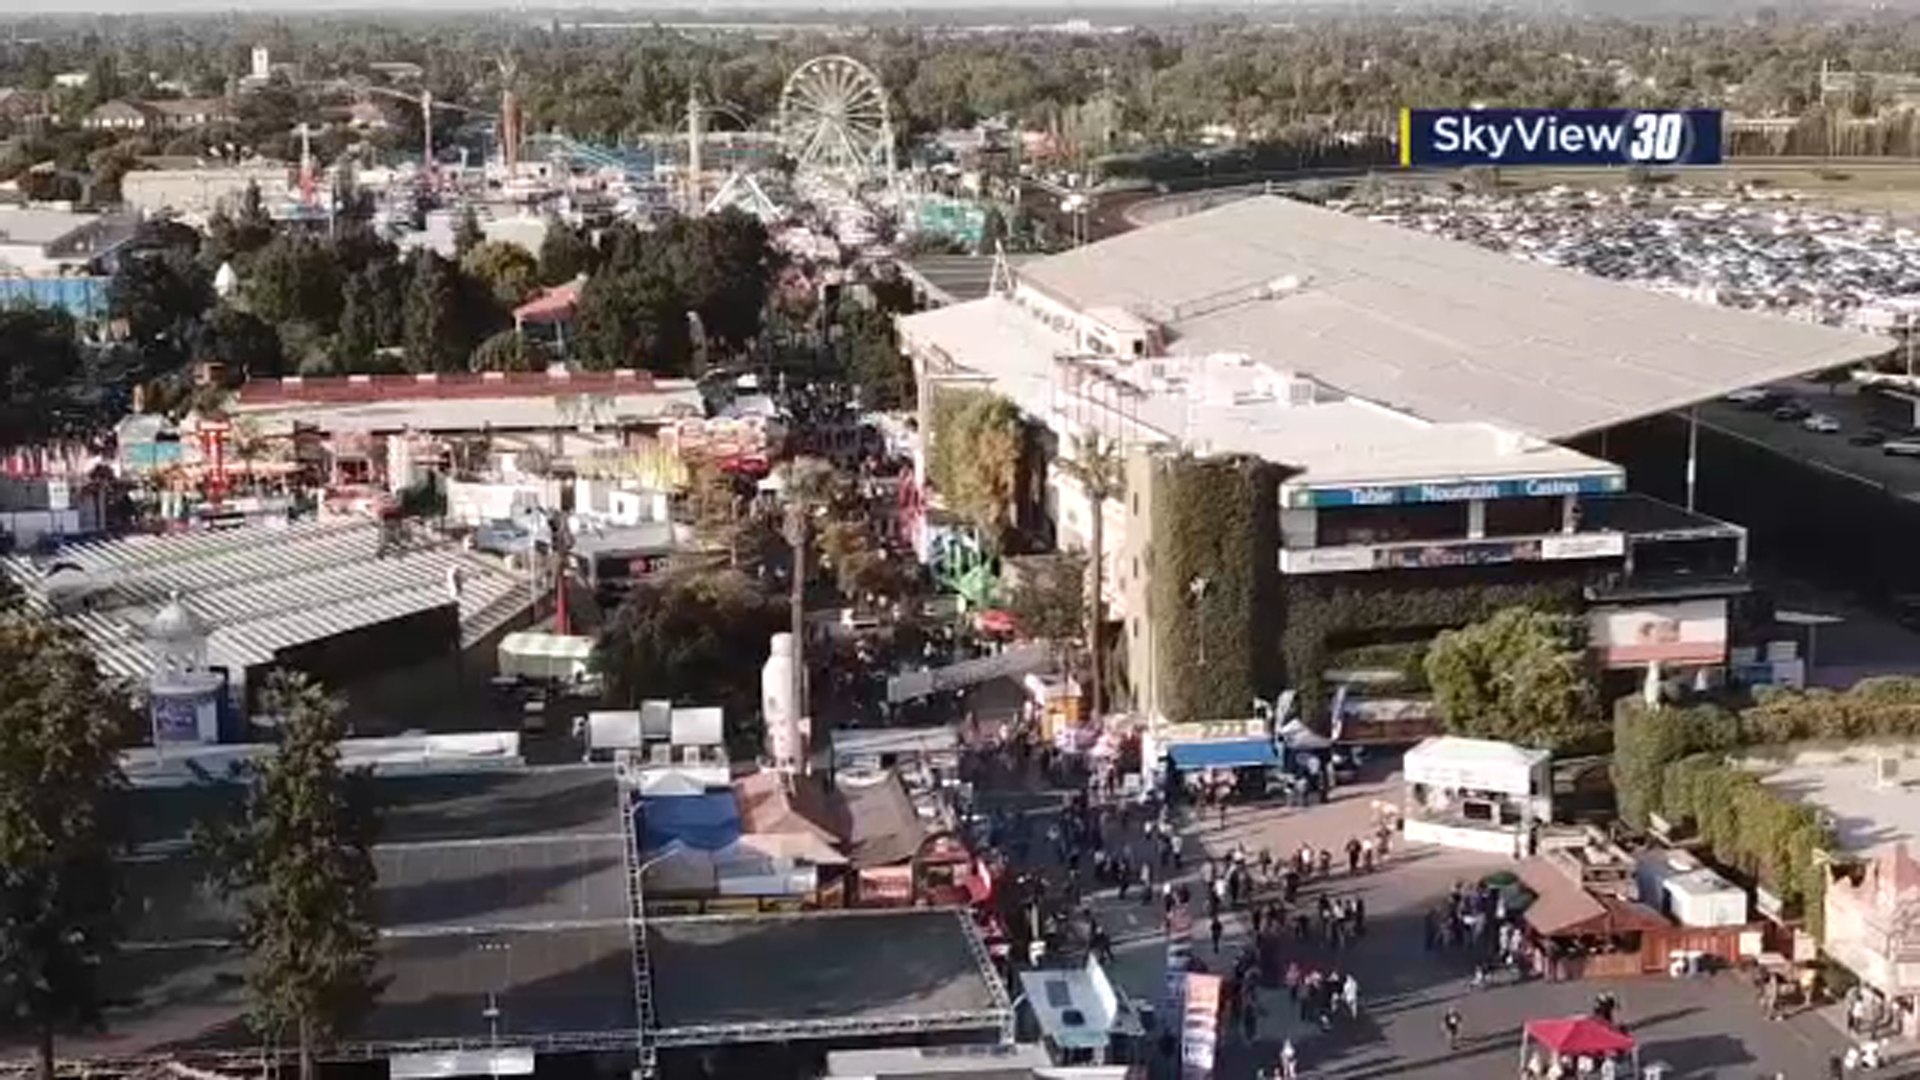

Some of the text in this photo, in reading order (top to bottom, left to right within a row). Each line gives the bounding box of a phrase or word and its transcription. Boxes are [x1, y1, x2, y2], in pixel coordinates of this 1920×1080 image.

[1351, 479, 1580, 505] Table Mountain Casino
